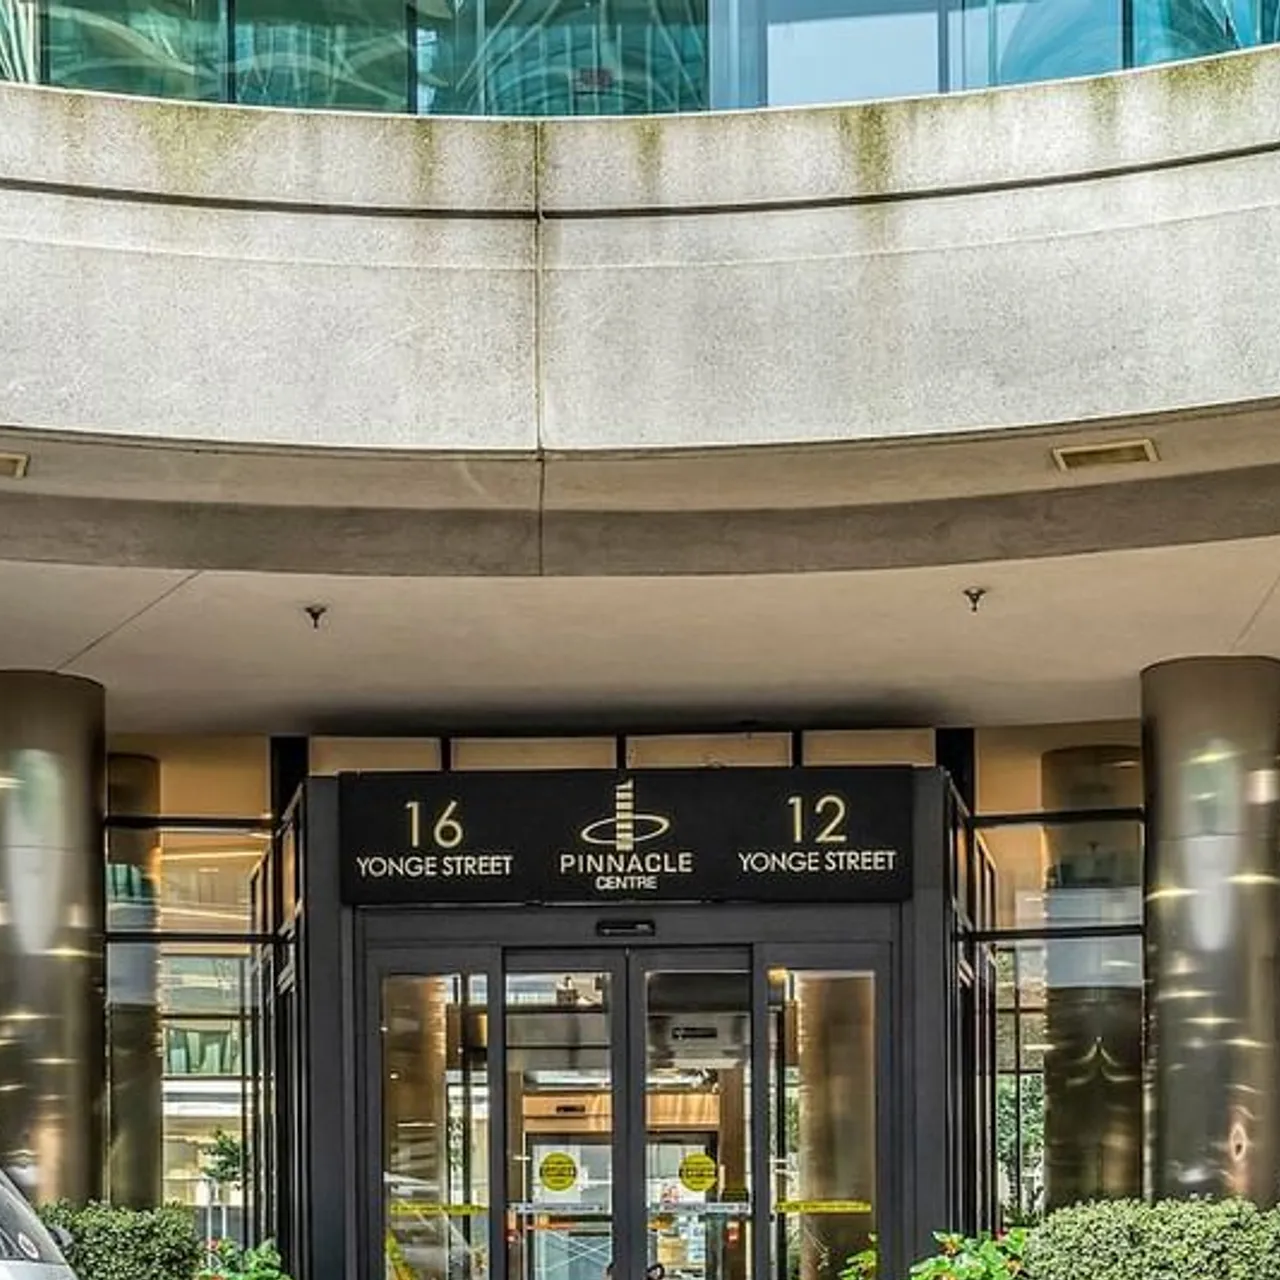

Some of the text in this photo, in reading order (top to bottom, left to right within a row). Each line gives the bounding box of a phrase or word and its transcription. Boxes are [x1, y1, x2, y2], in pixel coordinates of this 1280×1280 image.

[404, 800, 463, 848] 16
[787, 794, 847, 843] 12
[356, 855, 514, 877] YONGE STREET
[560, 852, 693, 874] PINNACLE
[738, 850, 897, 873] YONGE STREET
[595, 875, 658, 890] CENTRE
